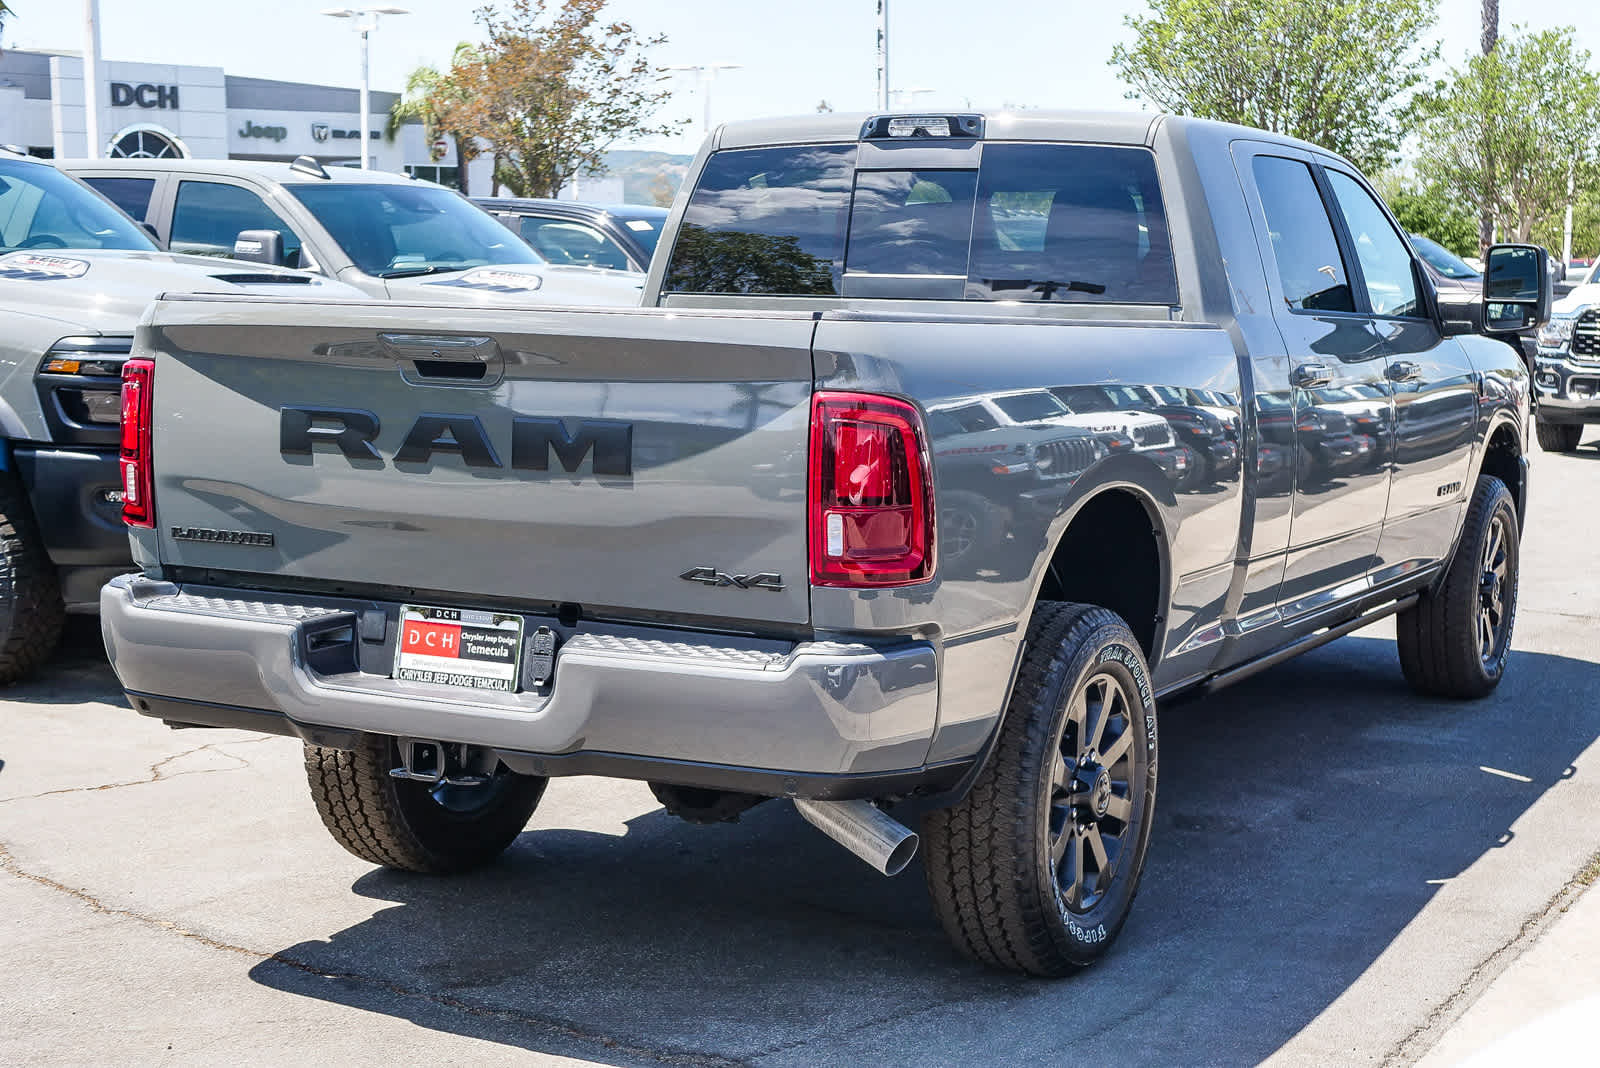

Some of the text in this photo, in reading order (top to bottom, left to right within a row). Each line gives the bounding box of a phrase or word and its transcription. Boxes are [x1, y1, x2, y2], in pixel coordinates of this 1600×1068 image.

[111, 83, 179, 109] DCH
[238, 120, 287, 142] Jeep
[280, 406, 633, 477] RAM
[1437, 481, 1462, 496] RAM
[171, 526, 274, 547] LARAMIE
[436, 609, 457, 619] DCH
[409, 629, 454, 648] DCH
[461, 632, 517, 646] Chrysler Jeep Dodge
[467, 643, 509, 657] Temecula
[400, 668, 433, 682] CHRYSLER
[433, 672, 448, 685] JEEP
[449, 674, 473, 687] DODGE
